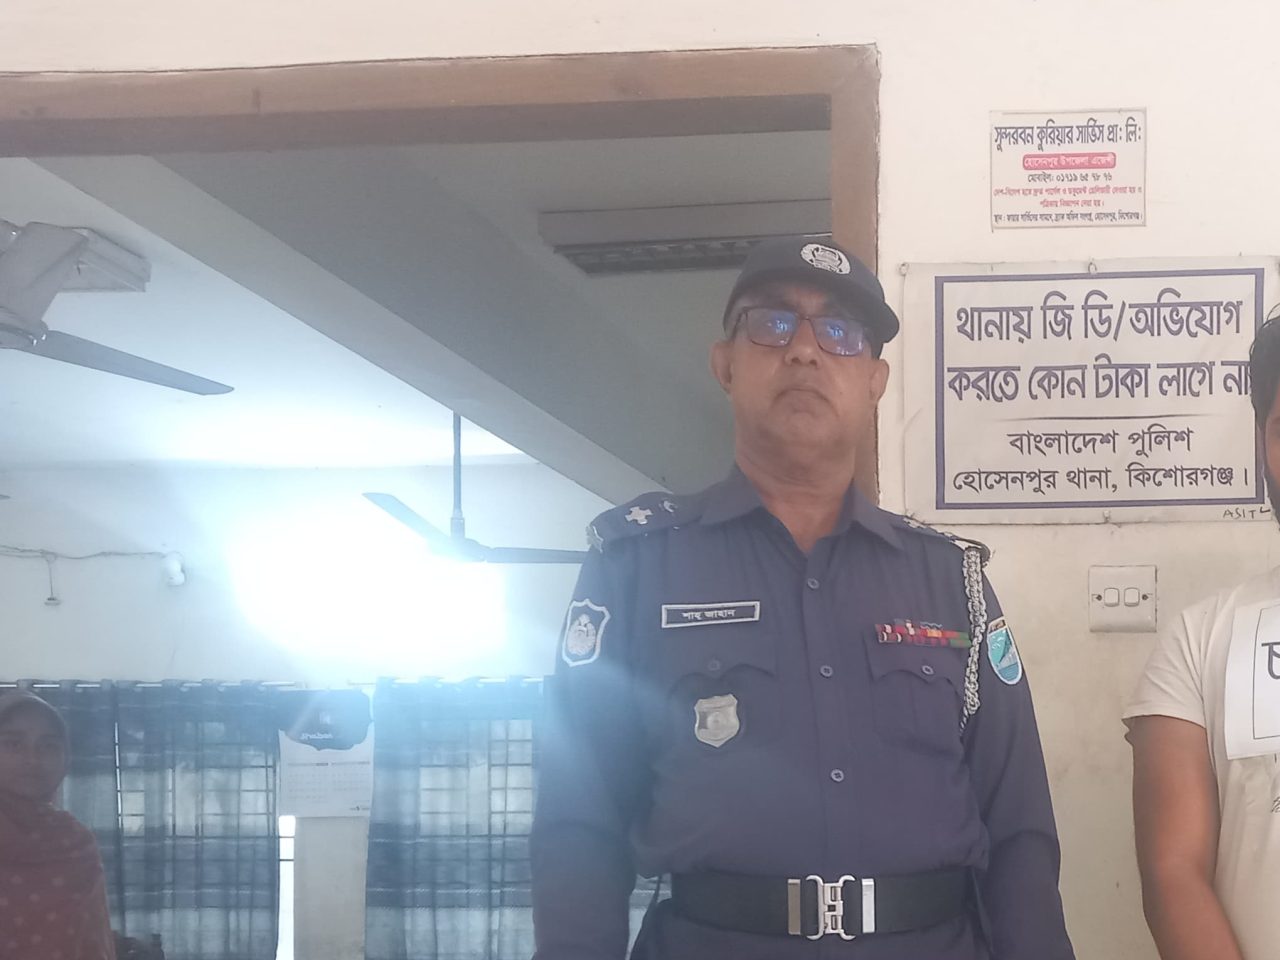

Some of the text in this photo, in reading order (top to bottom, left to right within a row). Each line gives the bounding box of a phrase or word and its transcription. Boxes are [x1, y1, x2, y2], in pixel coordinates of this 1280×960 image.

[994, 125, 1034, 152] সুন্দরবন
[1036, 119, 1074, 152] কুরিয়ার
[1076, 117, 1104, 144] সার্ভিস
[956, 305, 1033, 343] থানায়
[1040, 290, 1074, 341] জি
[947, 365, 1021, 403] করতে
[1028, 364, 1087, 400] কোন
[1093, 353, 1151, 399] টাকা
[1157, 361, 1215, 397] লাগে
[1007, 423, 1194, 457] বাংলাদেশ পুলিশ
[953, 468, 1057, 493] হোসেনপুর
[1066, 467, 1118, 493] থানা,
